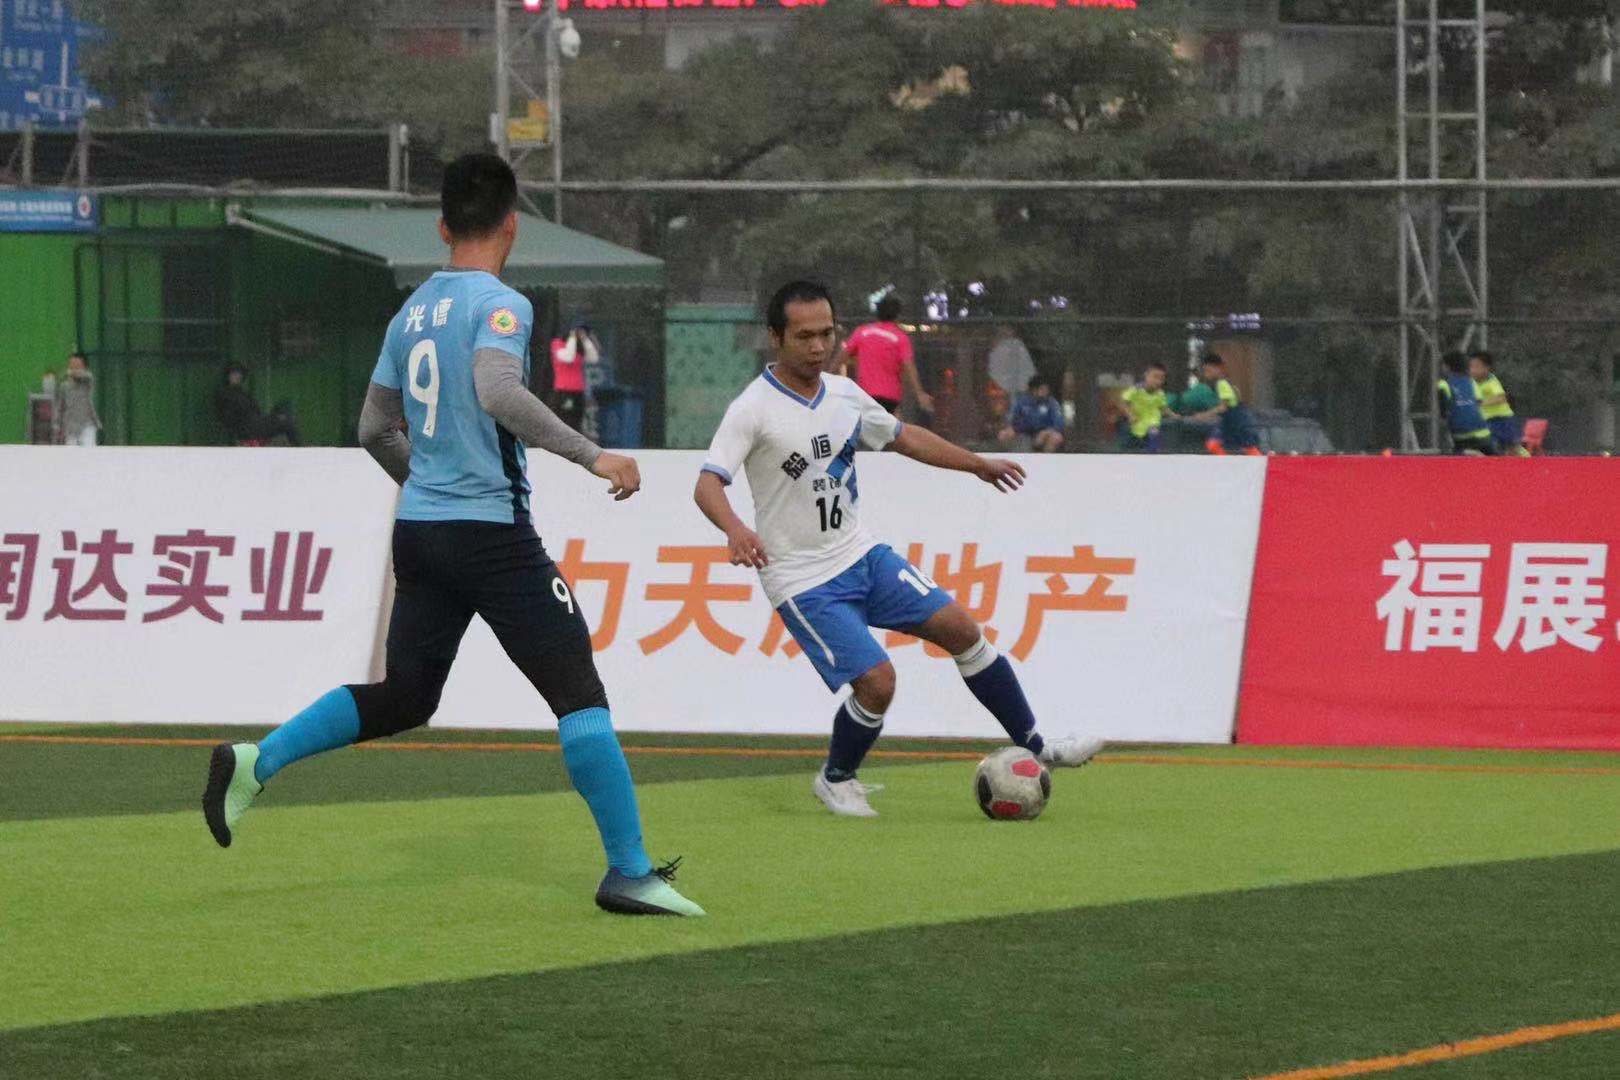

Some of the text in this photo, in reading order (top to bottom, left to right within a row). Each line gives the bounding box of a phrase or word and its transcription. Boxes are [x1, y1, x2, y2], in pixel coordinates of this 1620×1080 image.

[408, 339, 440, 438] 9
[816, 495, 843, 532] 16
[552, 576, 575, 614] 9
[557, 537, 1136, 664] 力天地产
[1375, 538, 1620, 654] 福展
